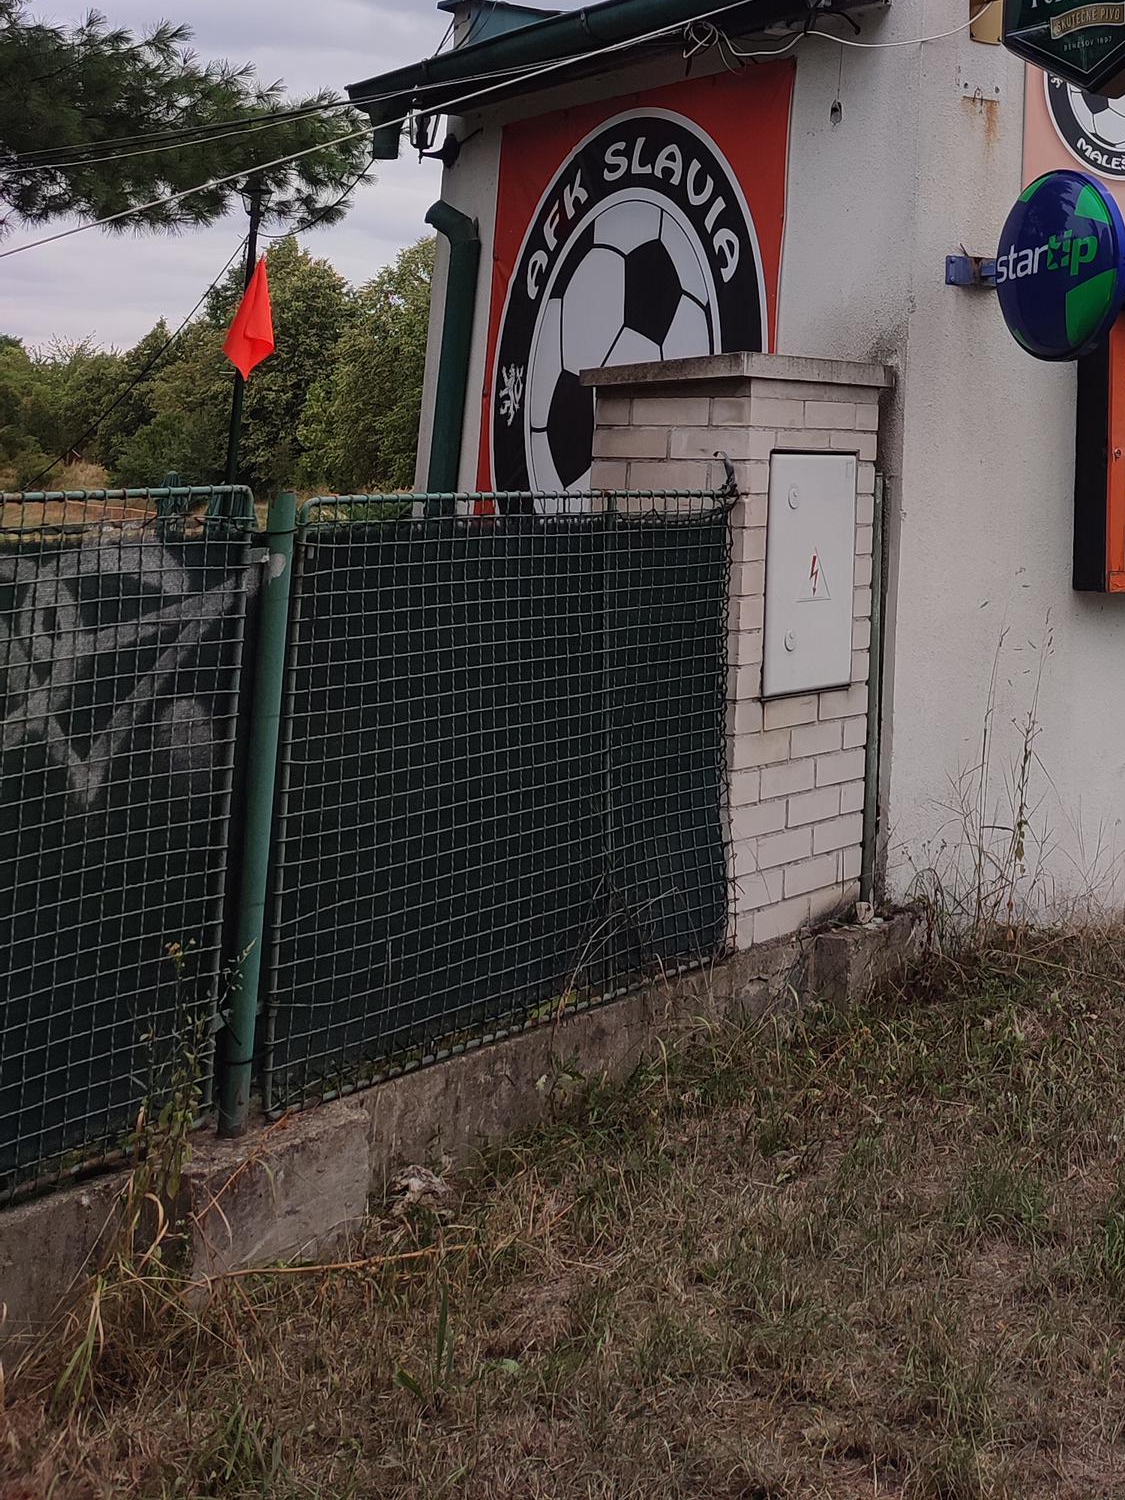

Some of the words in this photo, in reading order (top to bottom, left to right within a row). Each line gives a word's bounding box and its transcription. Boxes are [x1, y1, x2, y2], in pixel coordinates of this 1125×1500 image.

[1100, 8, 1120, 20] PIVO
[526, 168, 589, 300] AFK
[602, 136, 740, 283] SLAVIA
[996, 229, 1098, 283] startip
